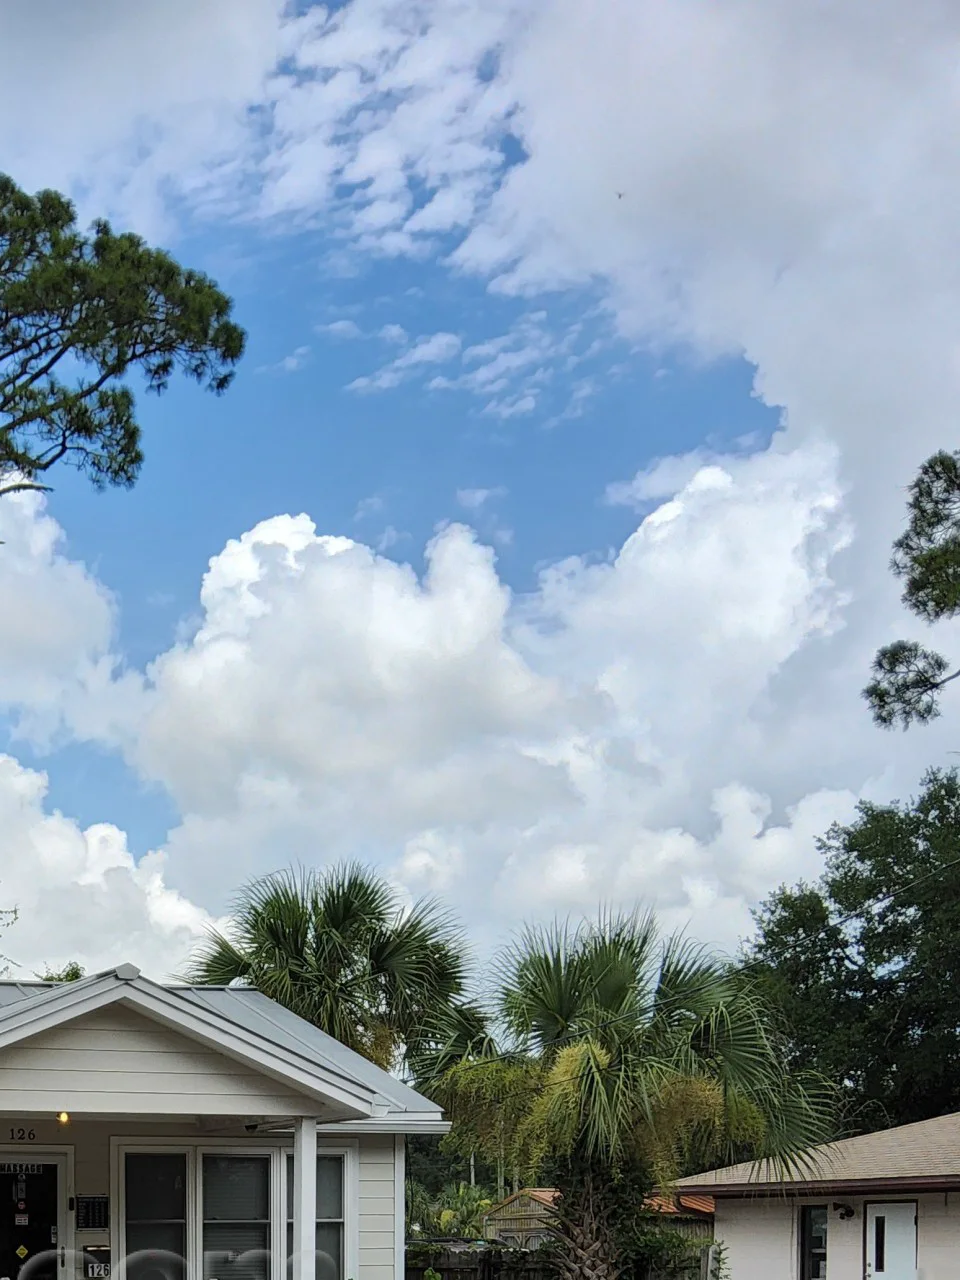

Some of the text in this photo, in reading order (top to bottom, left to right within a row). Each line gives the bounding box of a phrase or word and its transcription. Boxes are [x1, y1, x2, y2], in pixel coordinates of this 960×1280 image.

[10, 1128, 35, 1141] 126
[0, 1163, 42, 1173] MASSAGE
[89, 1264, 110, 1277] 126
